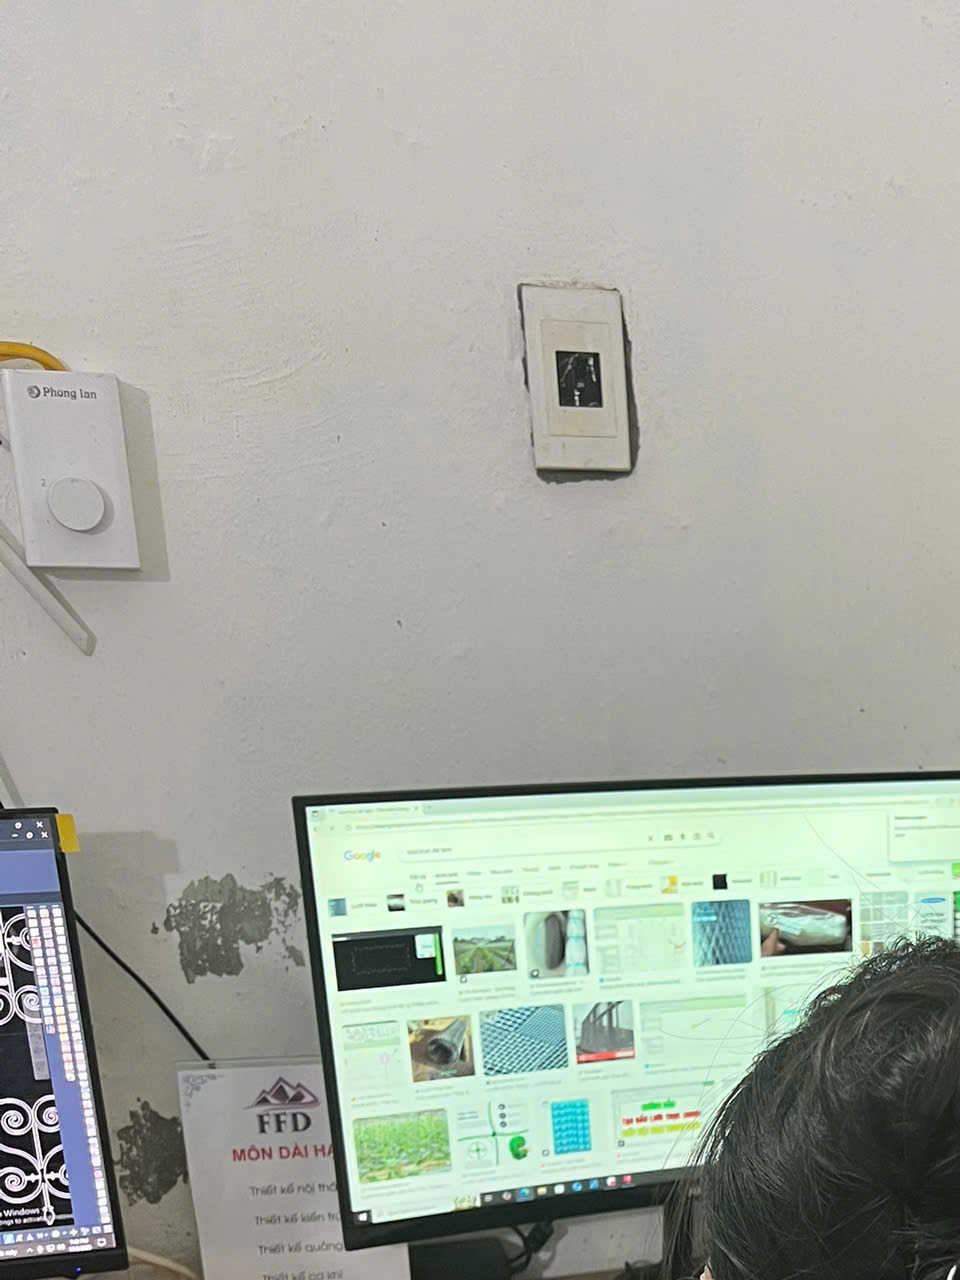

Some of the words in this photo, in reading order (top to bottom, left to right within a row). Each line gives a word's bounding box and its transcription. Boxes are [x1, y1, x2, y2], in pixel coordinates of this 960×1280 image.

[43, 387, 77, 400] Phong
[256, 1111, 312, 1134] FFD
[3, 1208, 40, 1217] Windows
